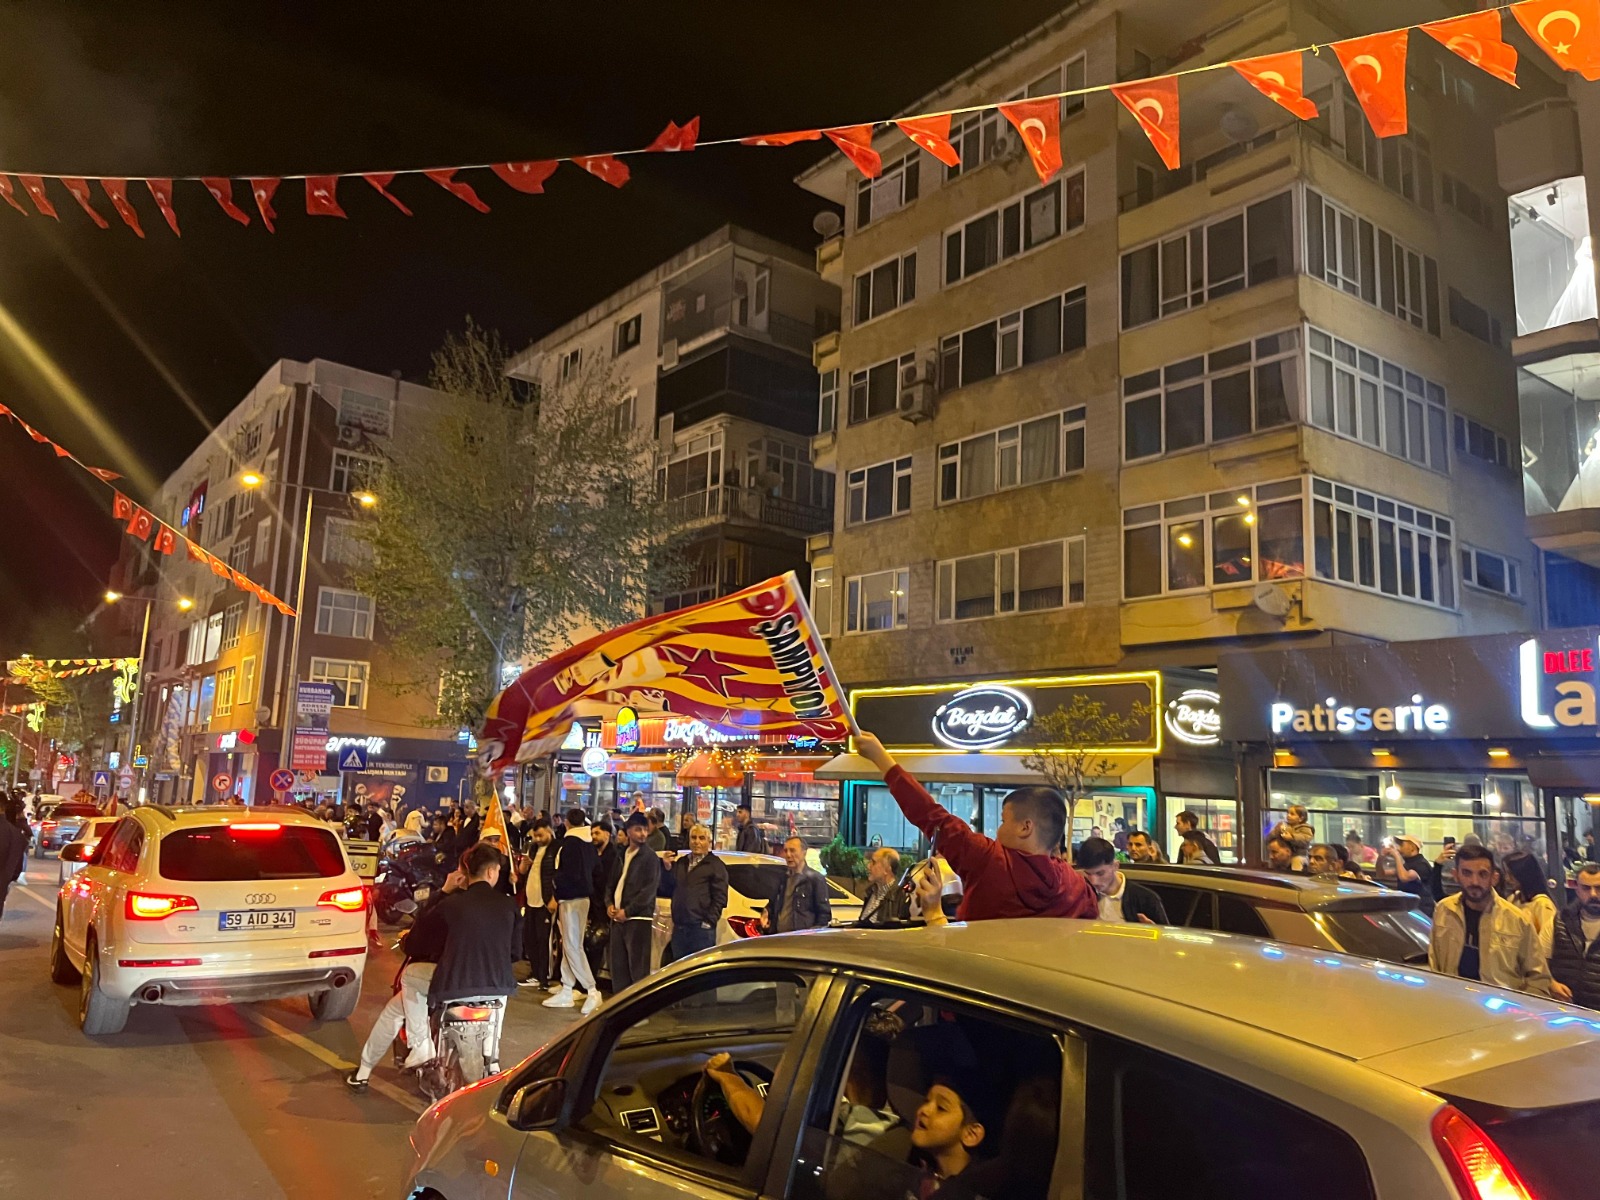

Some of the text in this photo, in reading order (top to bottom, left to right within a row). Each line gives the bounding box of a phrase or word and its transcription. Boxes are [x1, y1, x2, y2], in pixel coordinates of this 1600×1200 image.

[749, 612, 834, 720] ŞAMPİYON
[1519, 635, 1600, 728] La
[946, 705, 1017, 736] Bağdat
[1177, 704, 1220, 732] Bağda
[1271, 693, 1449, 733] Patisserie
[226, 912, 293, 926] 59 AID 341
